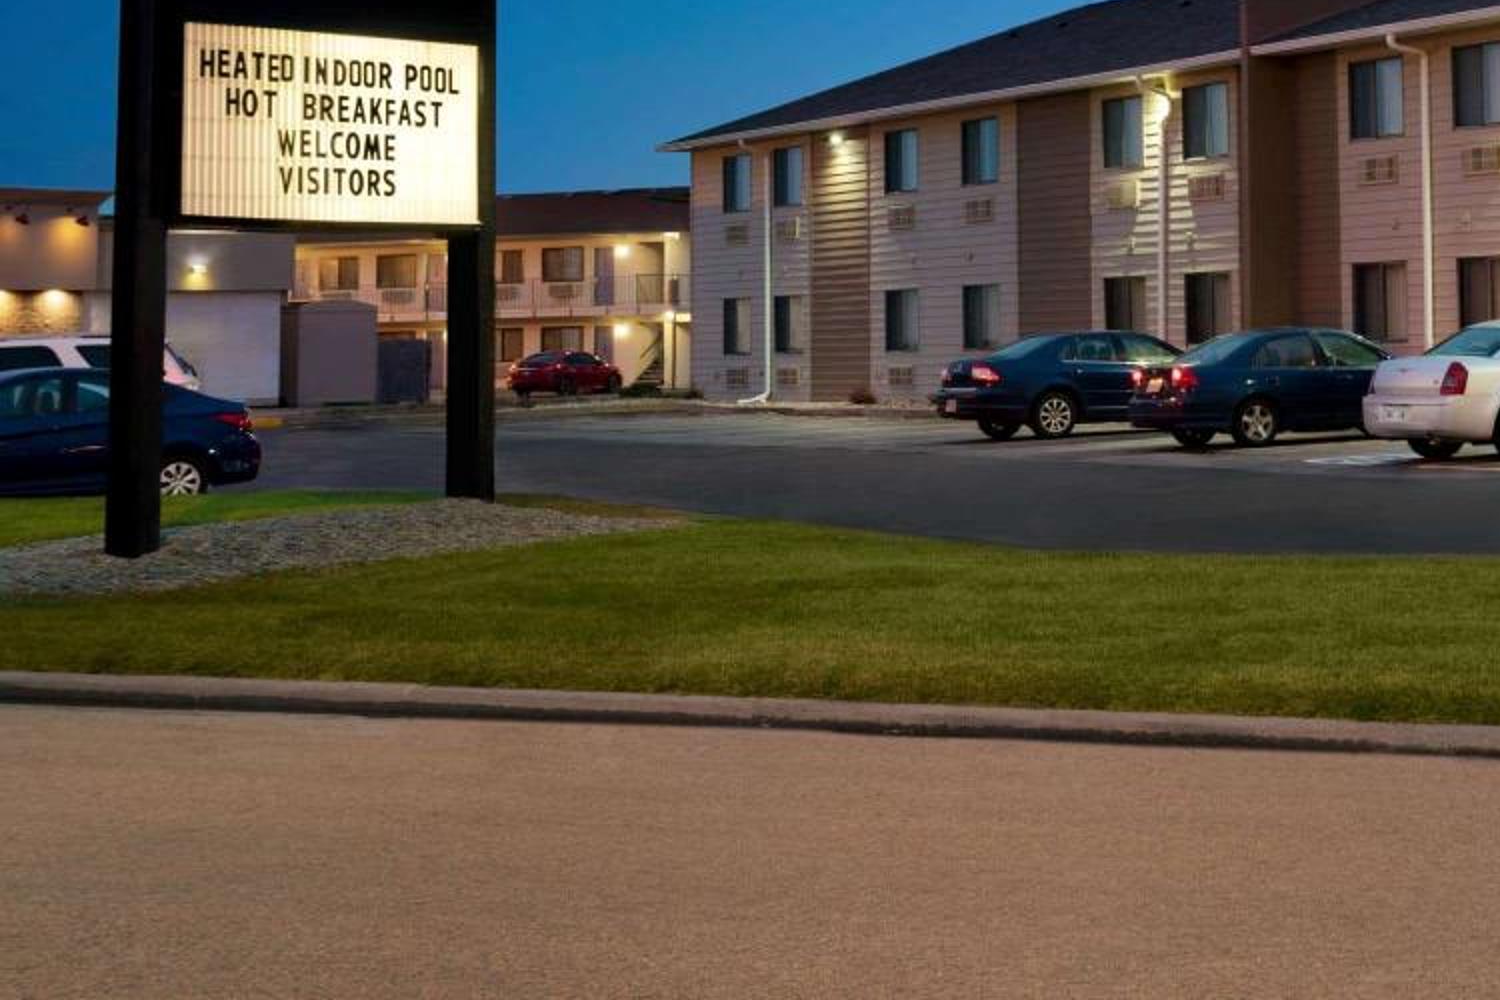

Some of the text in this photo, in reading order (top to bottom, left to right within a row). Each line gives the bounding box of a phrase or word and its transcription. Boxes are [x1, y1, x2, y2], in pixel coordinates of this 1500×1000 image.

[200, 49, 460, 95] HEATED INDOOR POOL
[225, 88, 443, 128] HOT BREAKFAST
[278, 129, 396, 161] WELCOME
[279, 166, 396, 197] VISITORS
